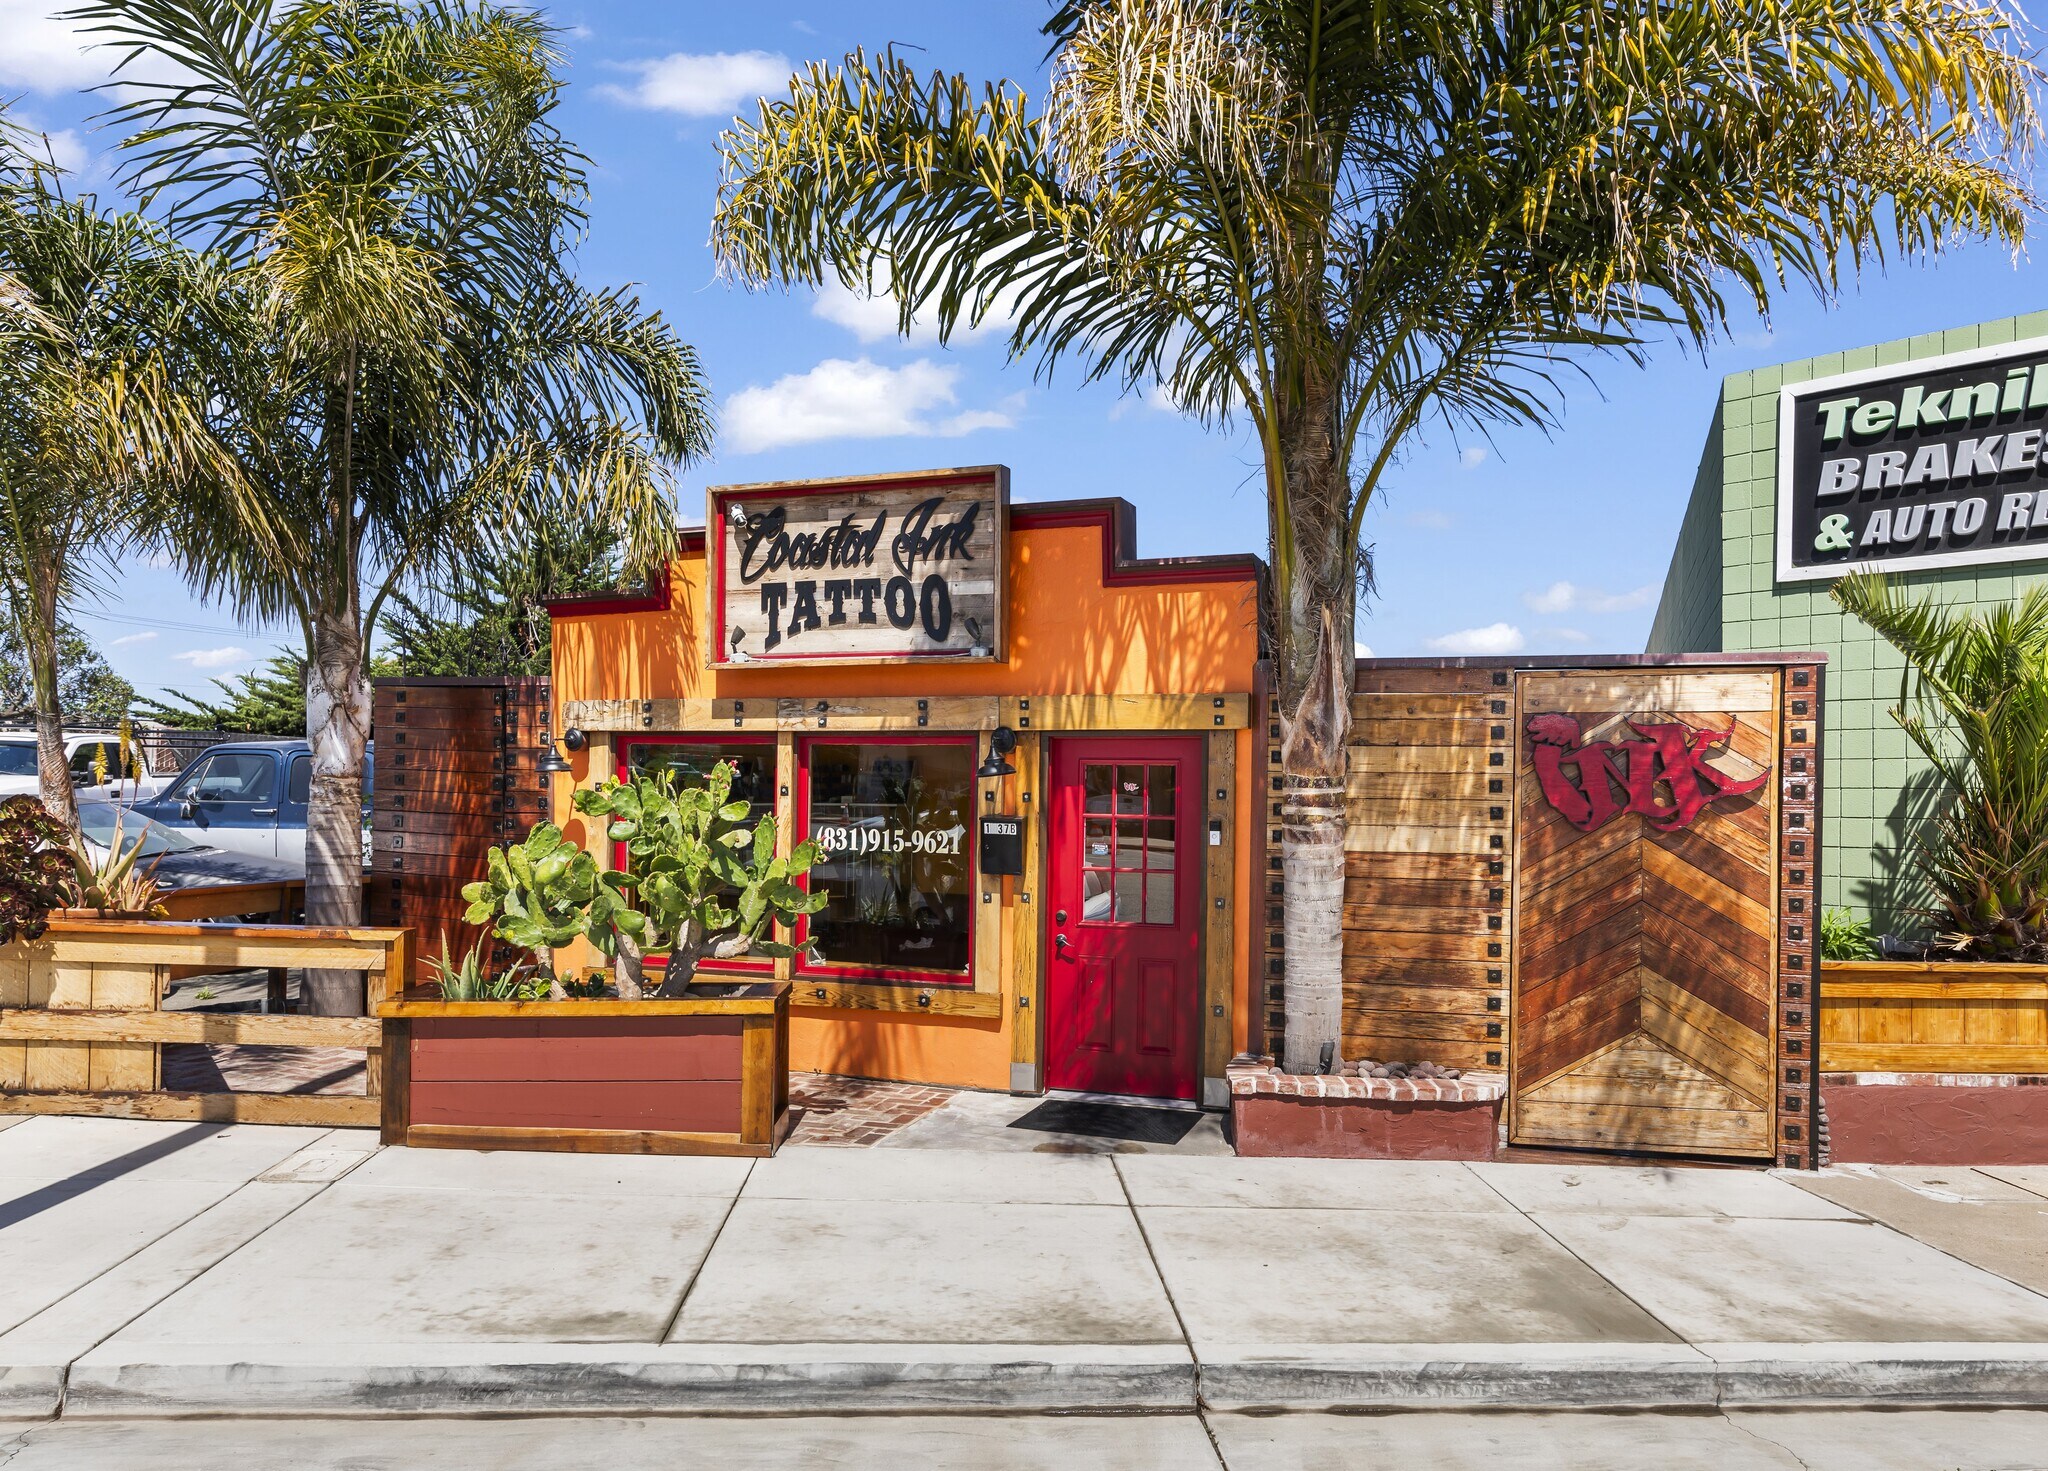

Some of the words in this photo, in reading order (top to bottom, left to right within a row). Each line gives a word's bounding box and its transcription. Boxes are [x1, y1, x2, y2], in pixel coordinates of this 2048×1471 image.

[1817, 429, 2048, 496] BRAKE
[741, 506, 888, 584] Coastal
[892, 497, 980, 582] Ink
[1814, 513, 1854, 552] &
[1860, 498, 1988, 546] AUTO
[761, 573, 951, 653] TATTOO
[816, 826, 961, 855] (831)915-9621
